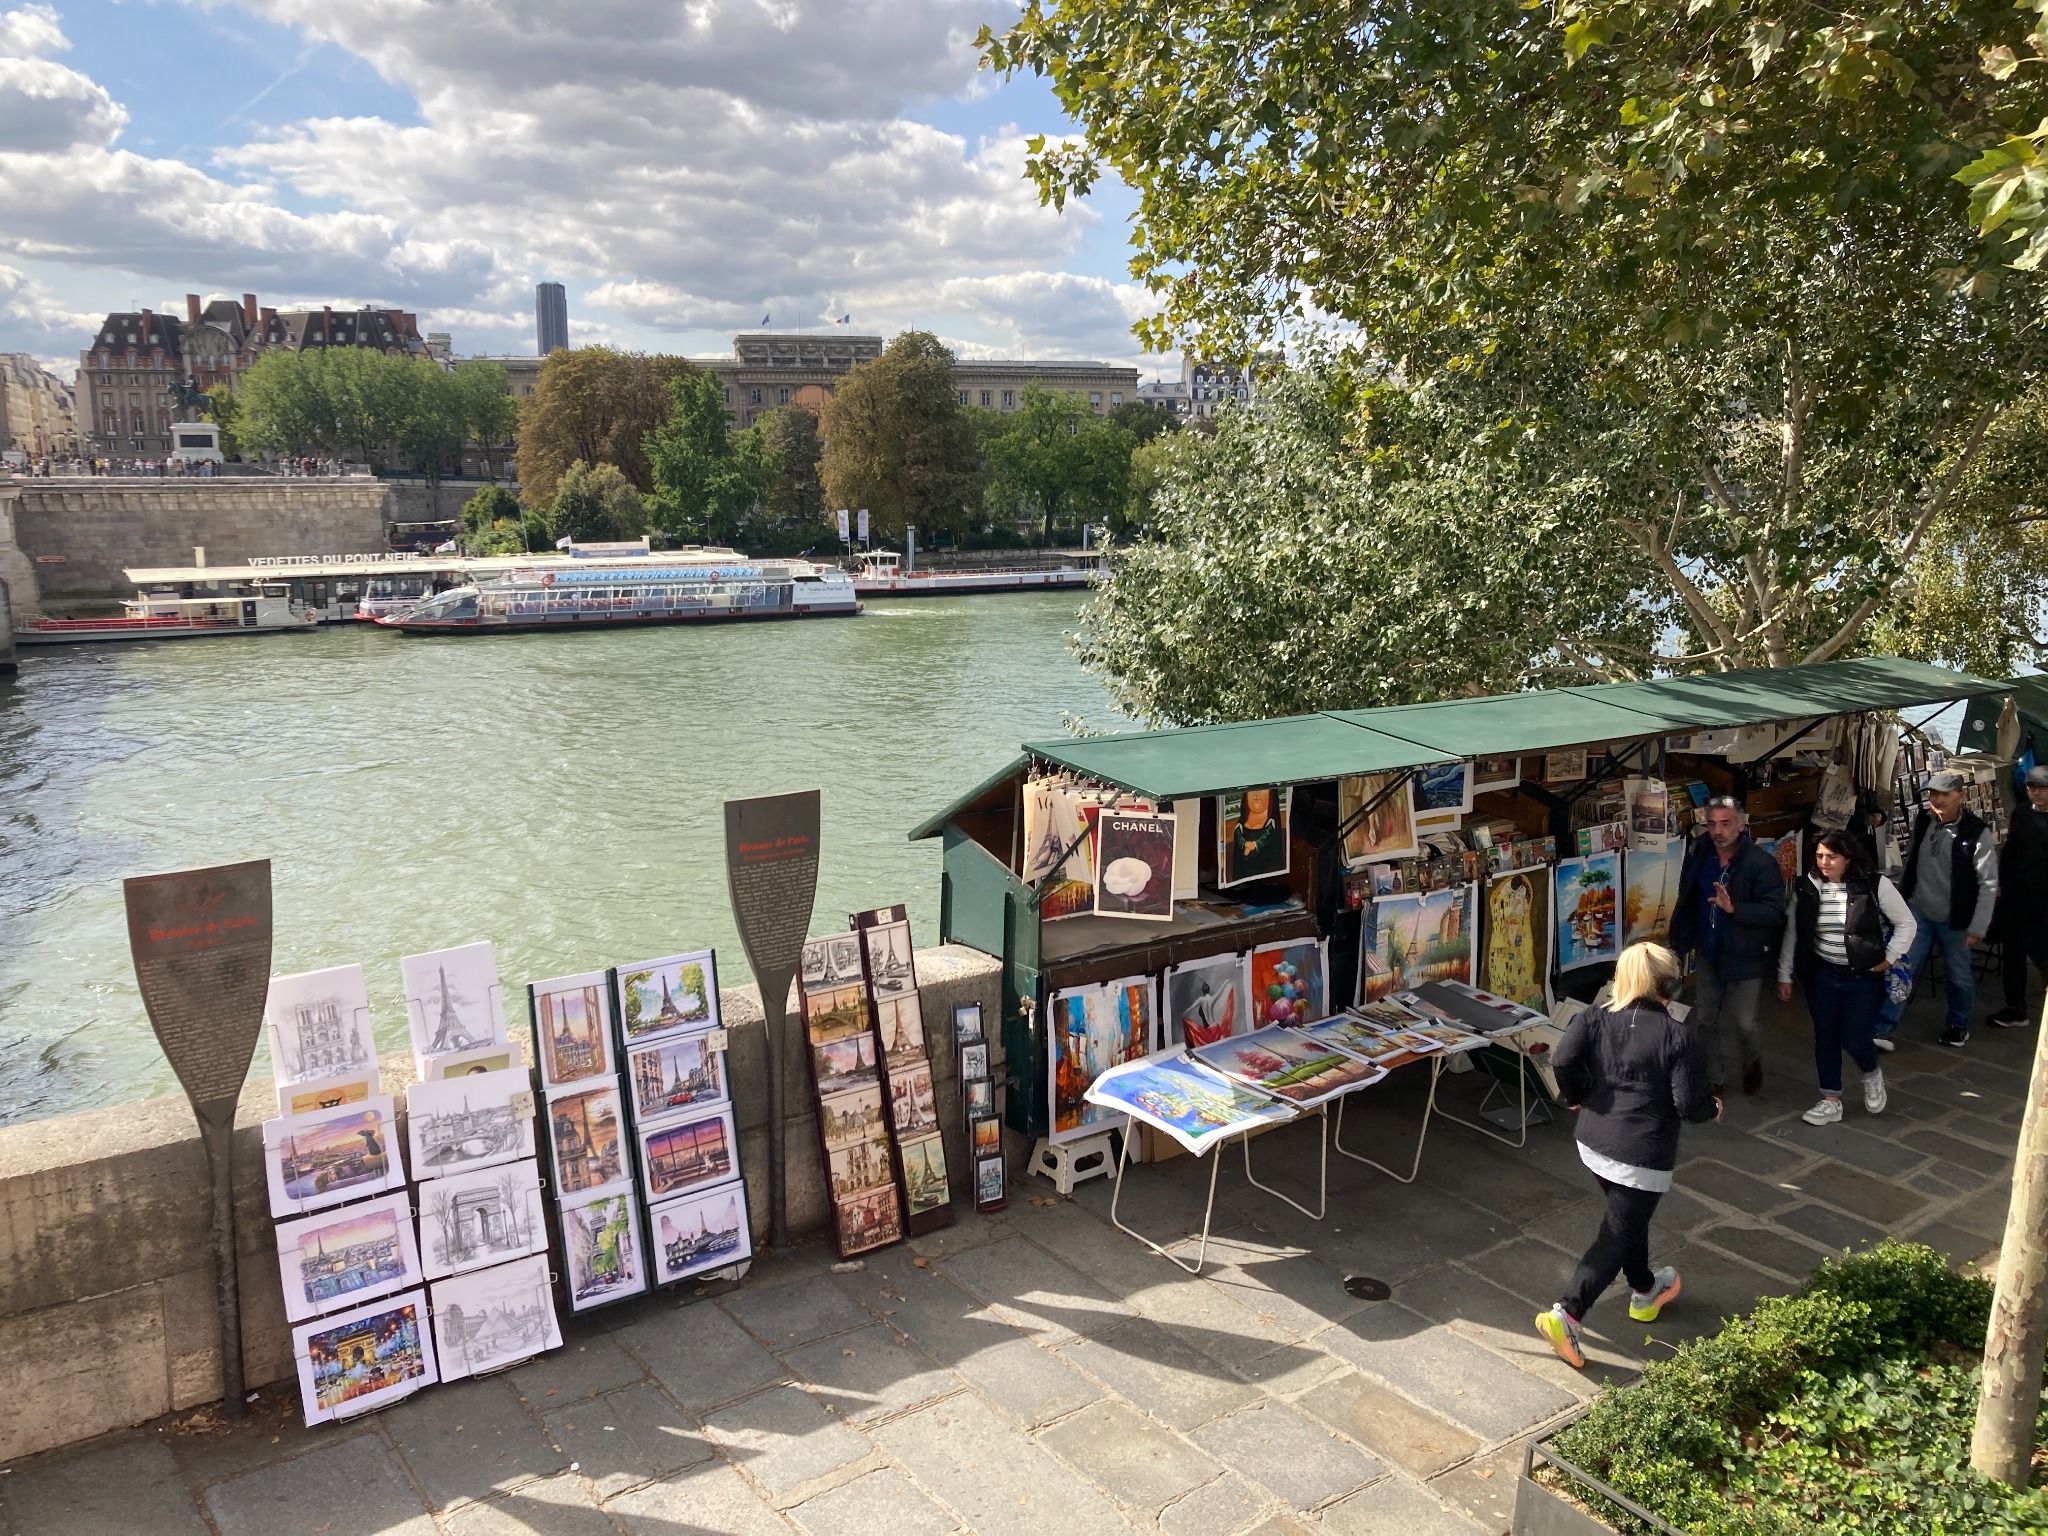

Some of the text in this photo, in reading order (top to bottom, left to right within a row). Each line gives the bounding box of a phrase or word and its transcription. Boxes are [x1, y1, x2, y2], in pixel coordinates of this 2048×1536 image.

[248, 555, 319, 567] VEDETTES
[323, 554, 341, 565] DU
[1112, 821, 1163, 833] CHANEL
[788, 835, 809, 846] Paris
[1637, 836, 1658, 846] Paris
